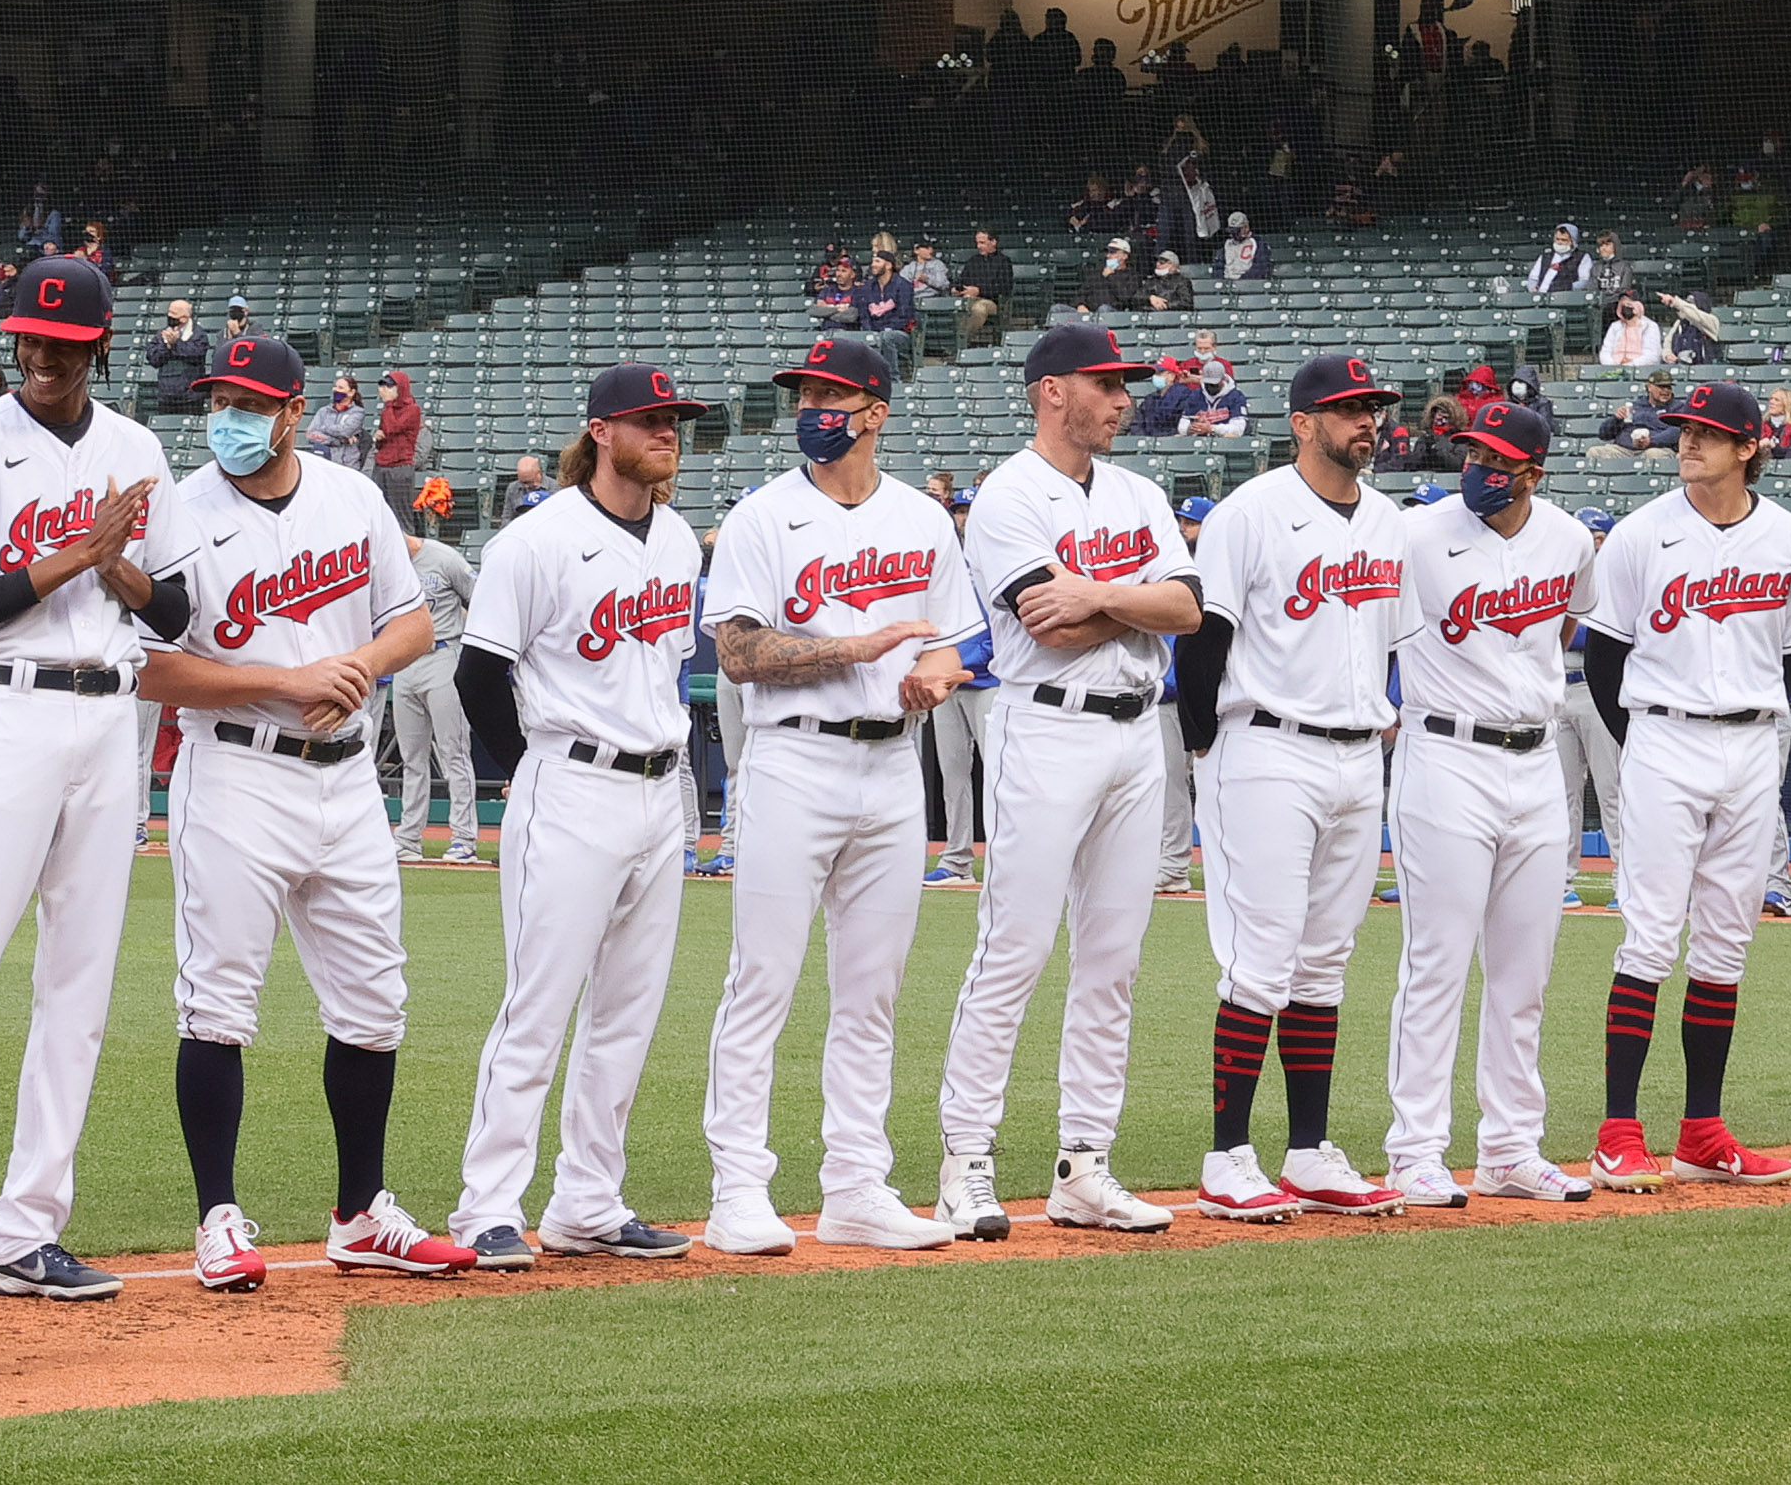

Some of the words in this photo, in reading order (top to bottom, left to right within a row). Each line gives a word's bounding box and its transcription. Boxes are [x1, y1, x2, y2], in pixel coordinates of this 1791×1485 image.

[37, 278, 67, 310] C
[228, 340, 256, 368] C
[808, 339, 835, 364] C
[1105, 329, 1123, 355] C
[1345, 357, 1370, 384] C
[649, 371, 674, 399] C
[1689, 386, 1714, 410] C
[1482, 404, 1510, 428] C
[576, 577, 694, 662] Indian
[967, 1160, 988, 1171] NIKE
